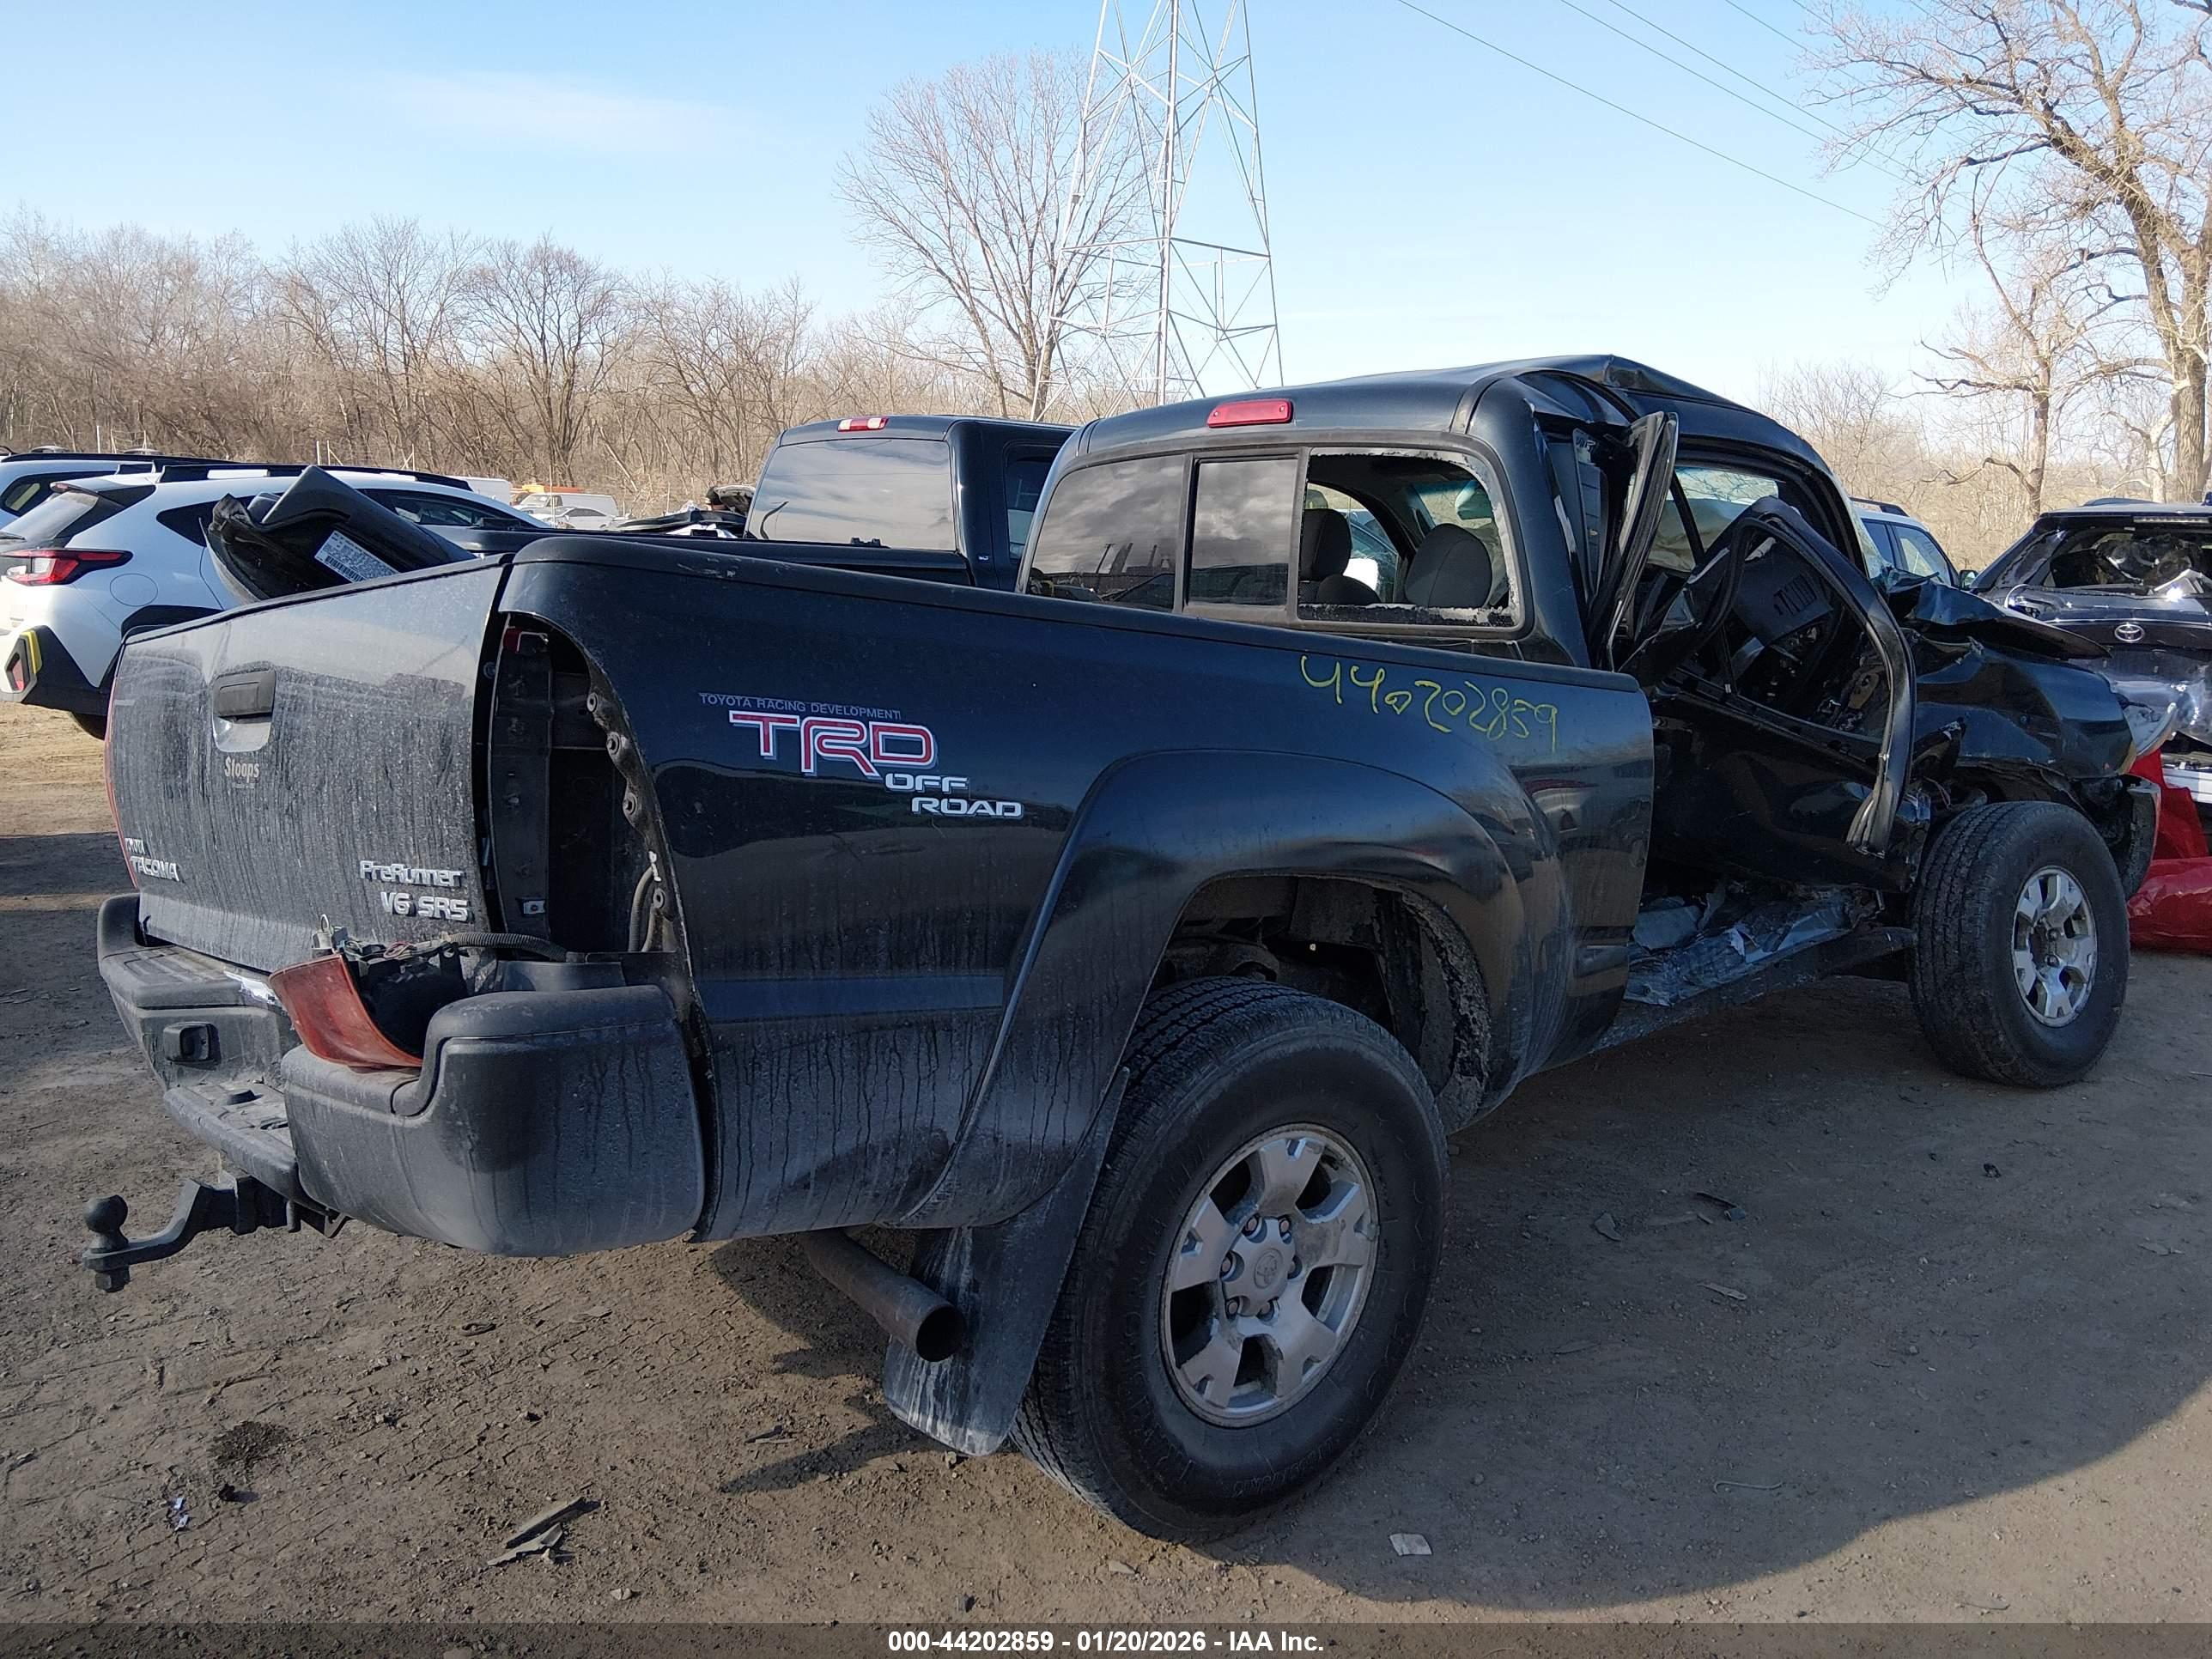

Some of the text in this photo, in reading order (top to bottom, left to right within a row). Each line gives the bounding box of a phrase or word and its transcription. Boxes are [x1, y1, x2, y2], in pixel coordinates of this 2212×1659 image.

[698, 692, 902, 720] TOYOTA RACING DEVELOPMENT
[729, 710, 935, 777] TRD
[224, 756, 260, 783] Stoops
[884, 772, 969, 793] OFF
[910, 796, 1024, 817] ROAD
[360, 860, 465, 887] PreRunner
[380, 891, 412, 915] V6
